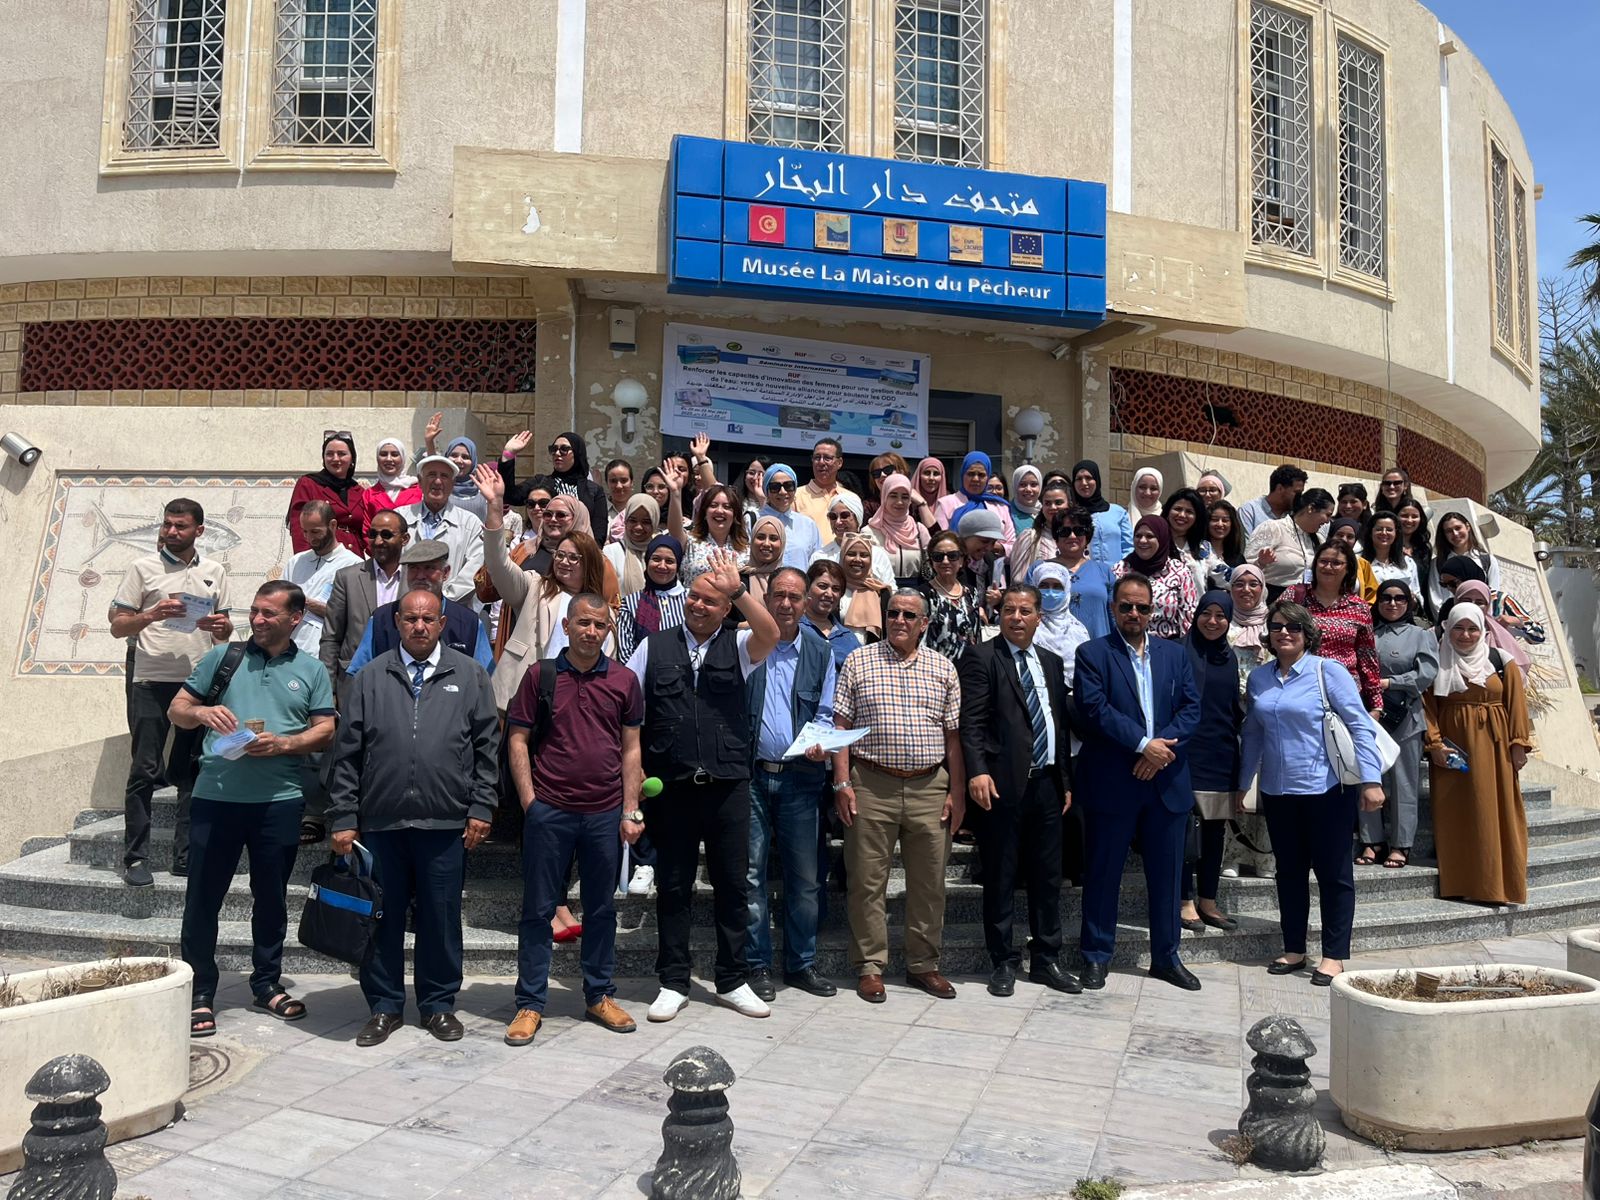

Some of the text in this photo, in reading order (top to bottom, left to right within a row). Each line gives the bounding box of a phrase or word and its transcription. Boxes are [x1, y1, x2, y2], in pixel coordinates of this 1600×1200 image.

[863, 169, 928, 209] دار
[943, 185, 1040, 217] متحف
[742, 257, 1052, 300] Musée La Maison du Pêcheur
[759, 360, 793, 368] Séminaire
[683, 365, 716, 374] Renforcer
[728, 371, 759, 380] capacités
[760, 375, 801, 384] d'innovation
[801, 378, 814, 386] des
[815, 380, 841, 389] femmes
[870, 387, 895, 395] gestion
[895, 390, 919, 398] durable
[765, 383, 797, 391] nouvelles
[797, 386, 826, 394] alliances
[843, 391, 869, 399] soutenir
